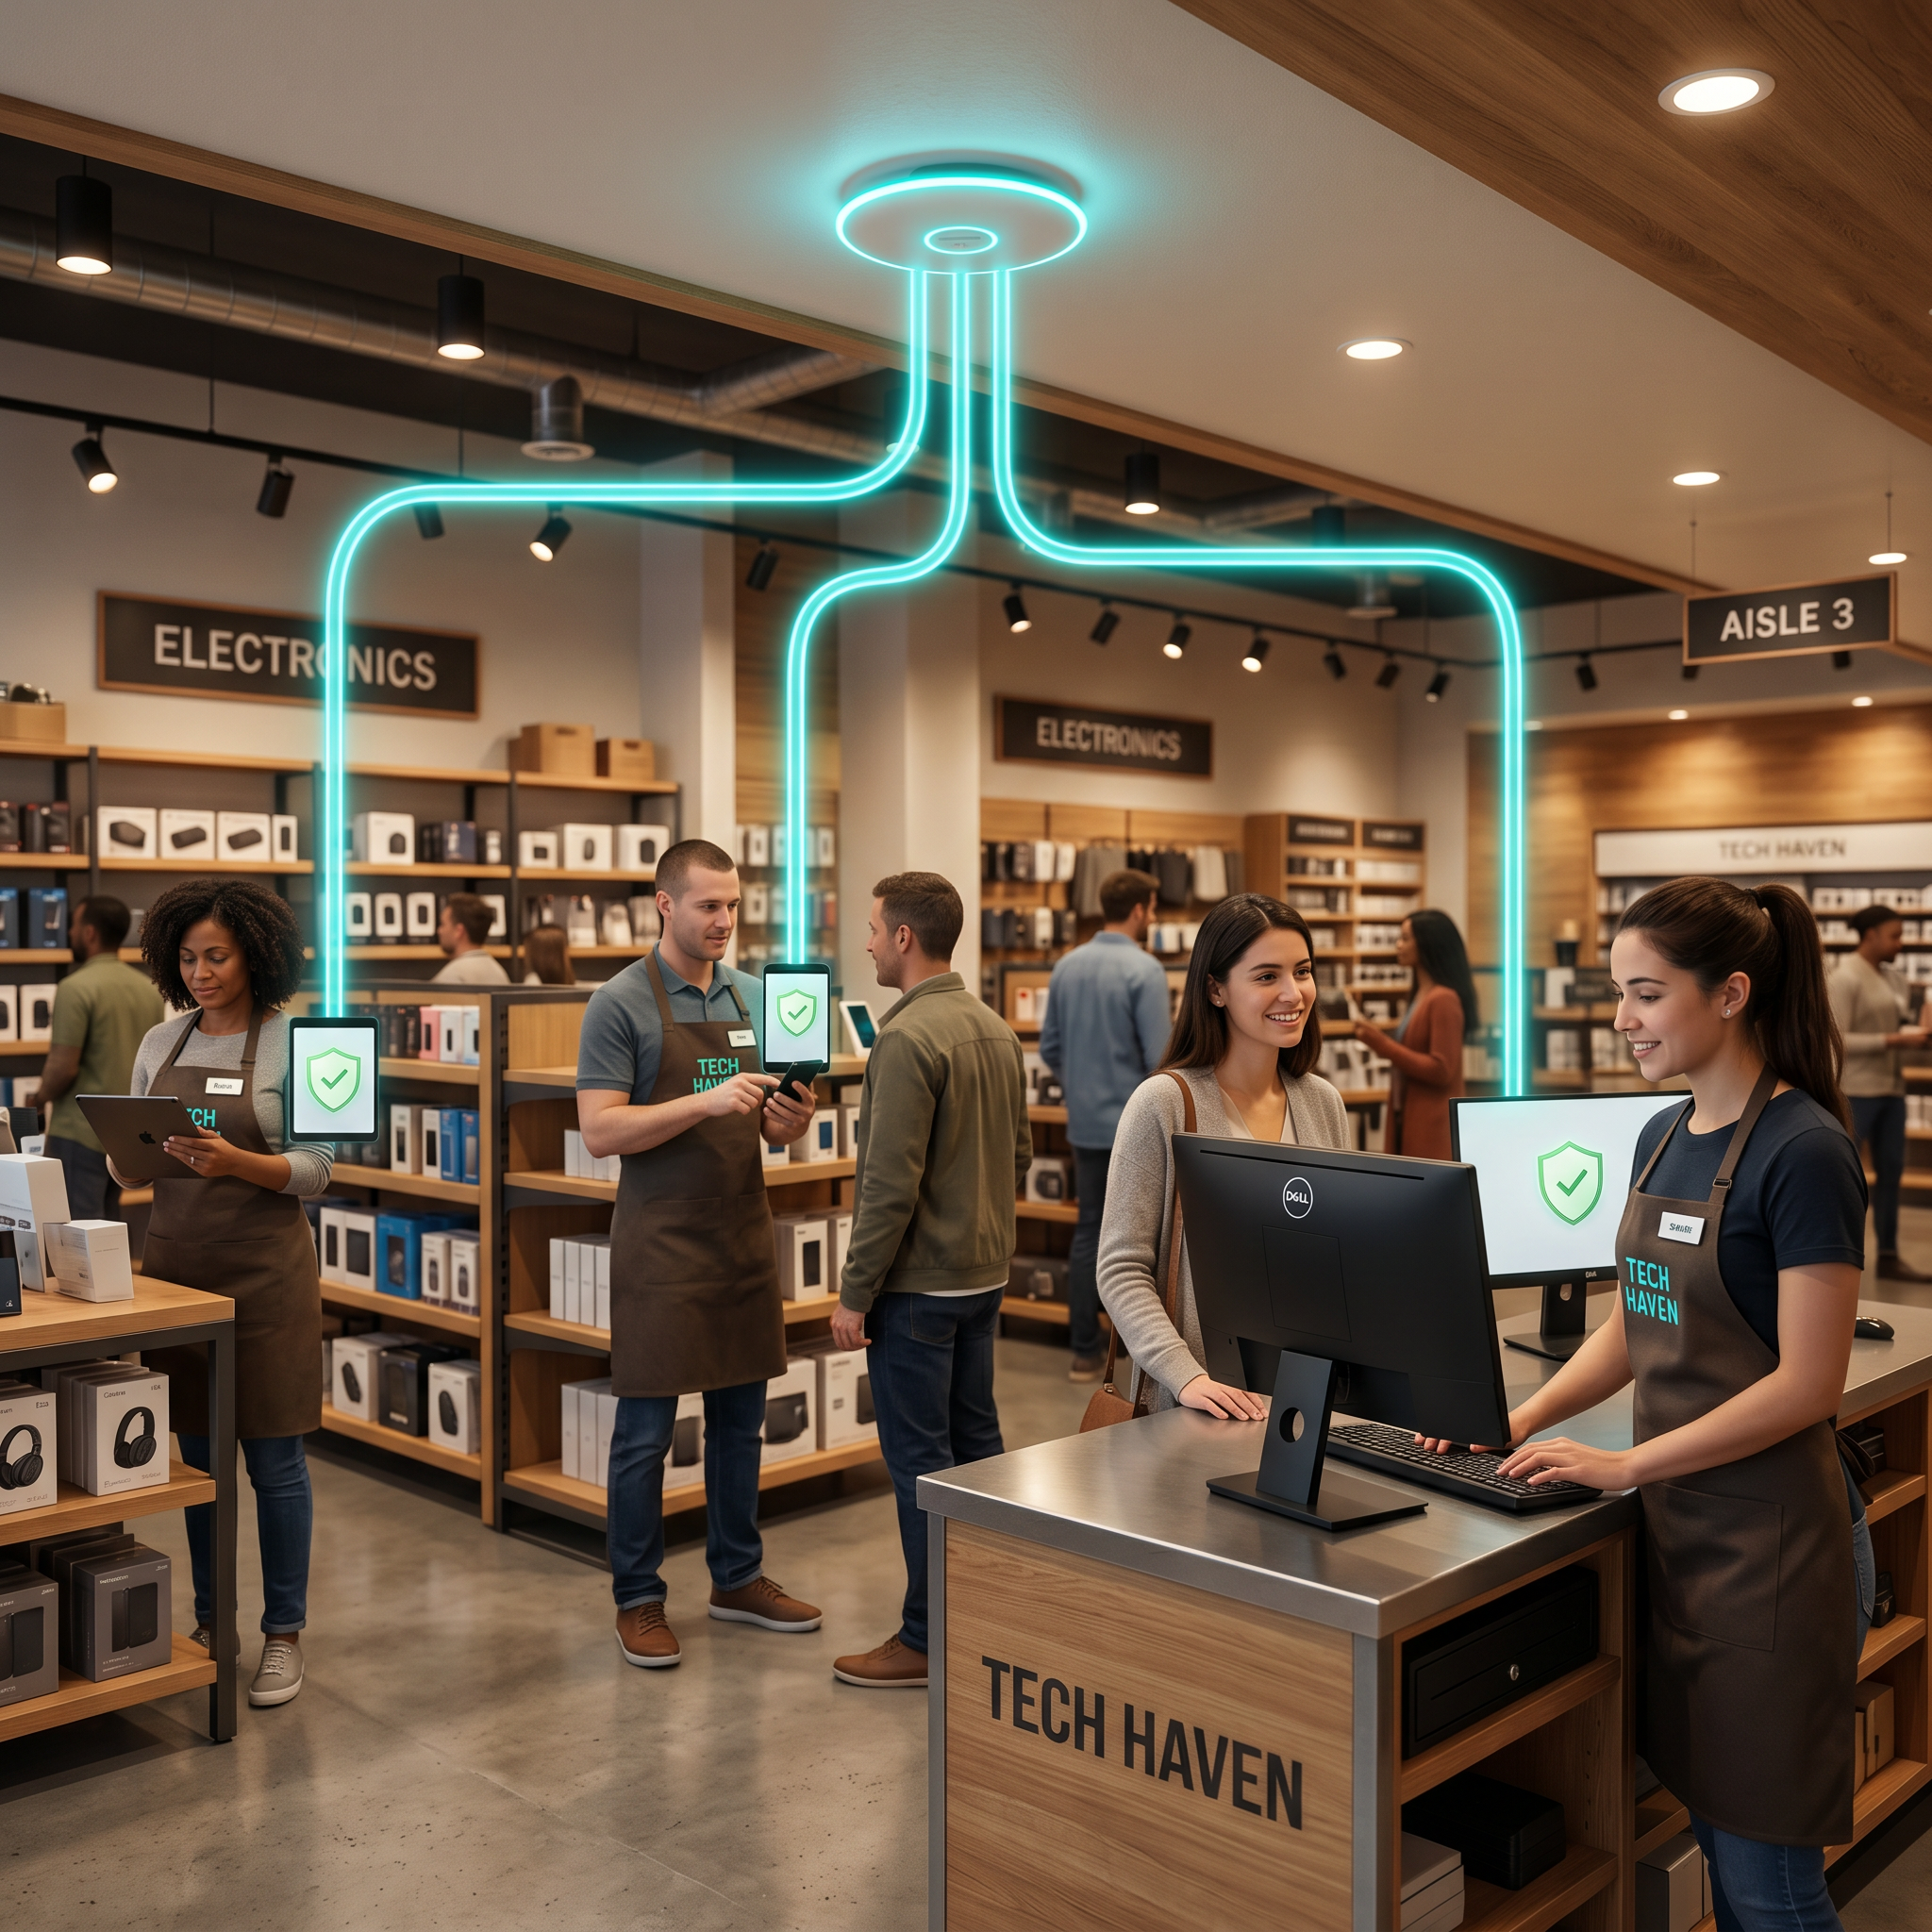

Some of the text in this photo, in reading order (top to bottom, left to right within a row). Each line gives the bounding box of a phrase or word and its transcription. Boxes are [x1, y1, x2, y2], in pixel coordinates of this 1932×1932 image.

[1720, 597, 1855, 642] AISLE 3
[1037, 716, 1182, 761] ELECTRONICS
[1720, 838, 1846, 859] TECH HAVEN
[697, 1058, 740, 1075] TECH
[1625, 1257, 1670, 1292] TECH
[1625, 1286, 1679, 1325] HAVEN
[982, 1655, 1302, 1831] TECH HAVEN
